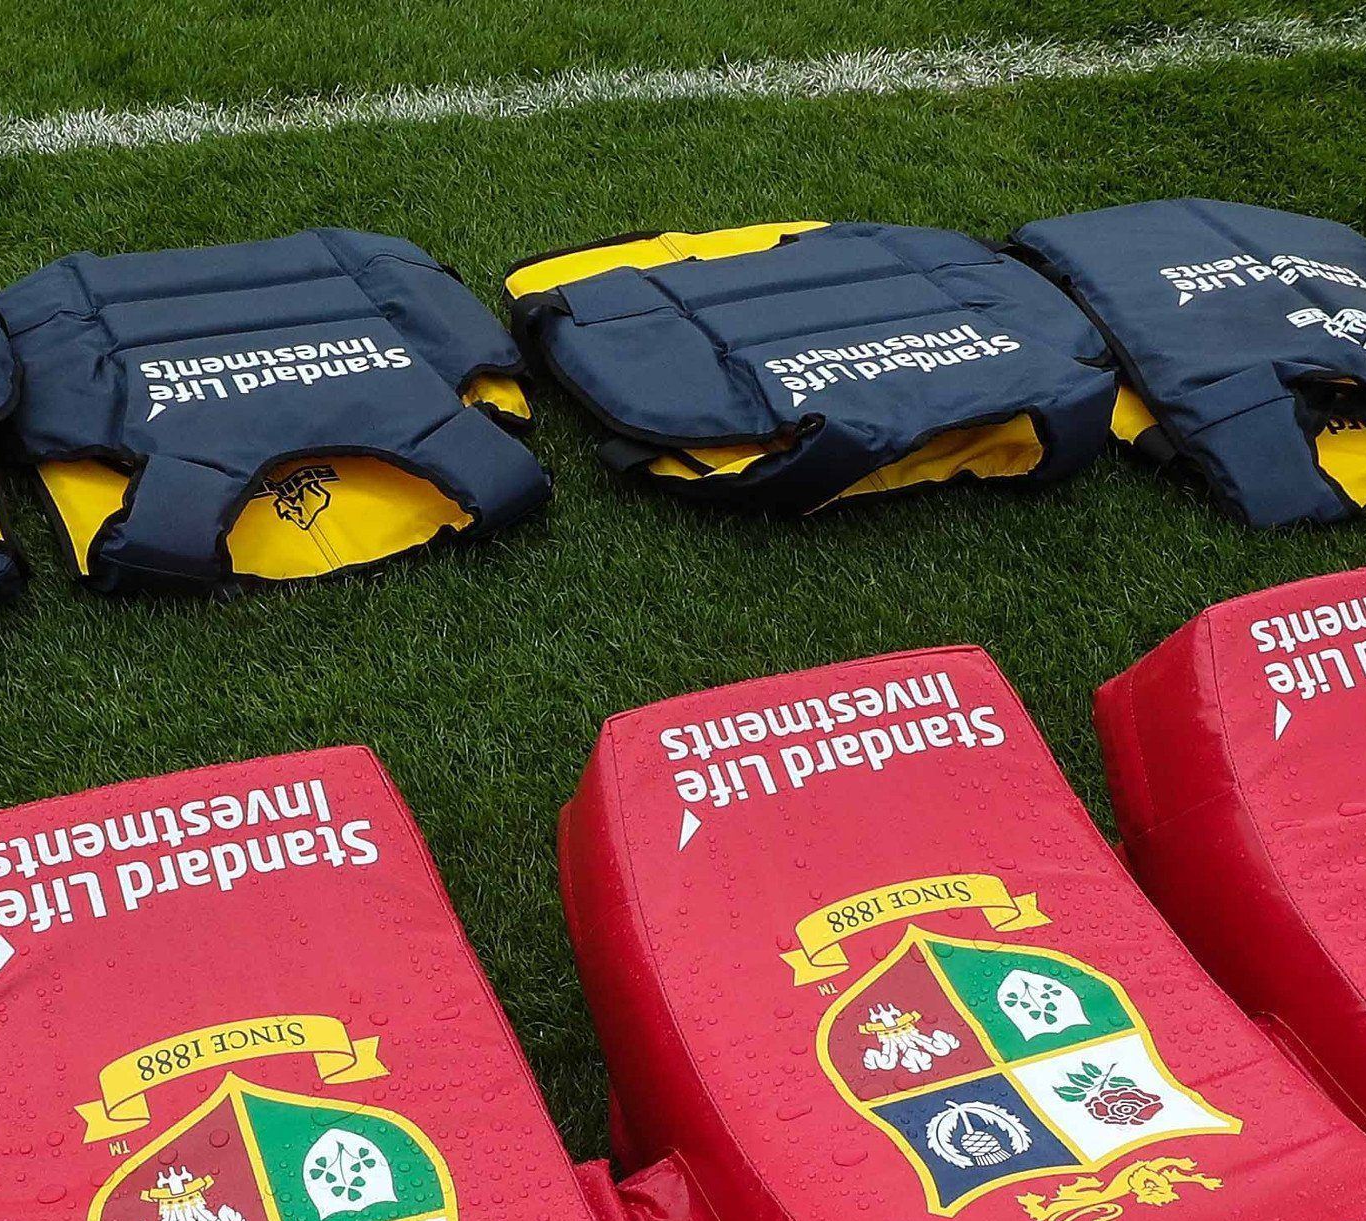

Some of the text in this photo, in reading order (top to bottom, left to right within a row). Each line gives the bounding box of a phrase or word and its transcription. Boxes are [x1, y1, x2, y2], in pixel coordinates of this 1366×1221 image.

[1173, 273, 1247, 292] Life
[140, 337, 378, 379] Investments
[149, 348, 412, 402] Standard Life
[765, 325, 982, 374] Investments
[781, 334, 1021, 391] Standard Life
[255, 464, 340, 498] RHIN
[1264, 648, 1355, 700] Life
[659, 672, 961, 762] Investments
[673, 705, 1006, 808] Standard Life
[116, 820, 379, 911] Standard
[826, 880, 973, 934] SINCE 1888
[135, 1021, 306, 1083] SINCE 1888
